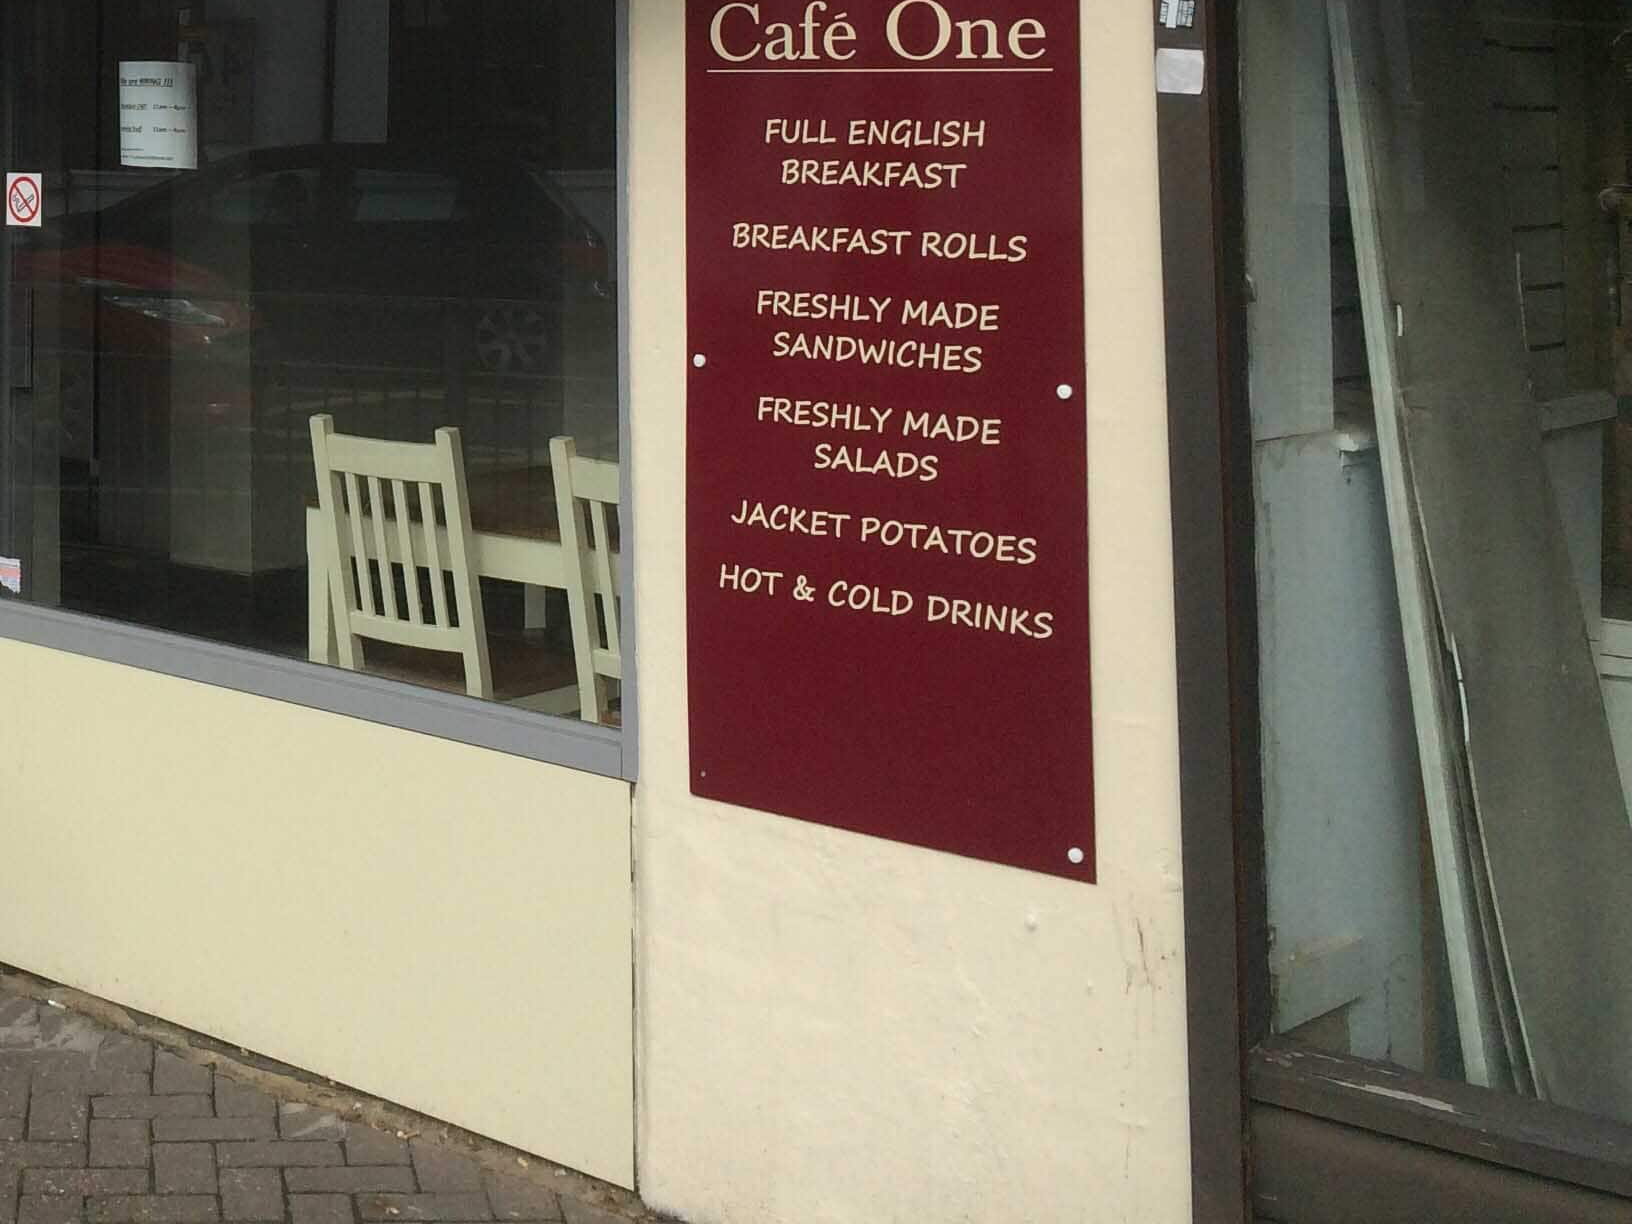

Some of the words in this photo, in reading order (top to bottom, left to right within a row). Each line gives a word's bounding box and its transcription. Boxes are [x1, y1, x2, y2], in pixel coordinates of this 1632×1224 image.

[711, 1, 856, 61] Café
[766, 119, 836, 143] FULL
[849, 120, 985, 148] ENGLISH
[782, 159, 967, 188] BREAKFAST
[733, 223, 911, 254] BREAKFAST
[922, 232, 1027, 262] ROLLS
[758, 291, 891, 322] FRESHLY
[902, 300, 999, 330] MADE
[773, 332, 983, 373] SANDWICHES
[758, 397, 892, 433] FRESHLY
[903, 411, 1001, 444] MADE
[815, 444, 938, 481] SALADS
[731, 500, 850, 537] JACKET
[862, 518, 1036, 564] POTATOES
[720, 564, 783, 595] HOT
[793, 575, 815, 601] &
[829, 581, 913, 615] COLD
[928, 596, 1053, 638] DRINKS
